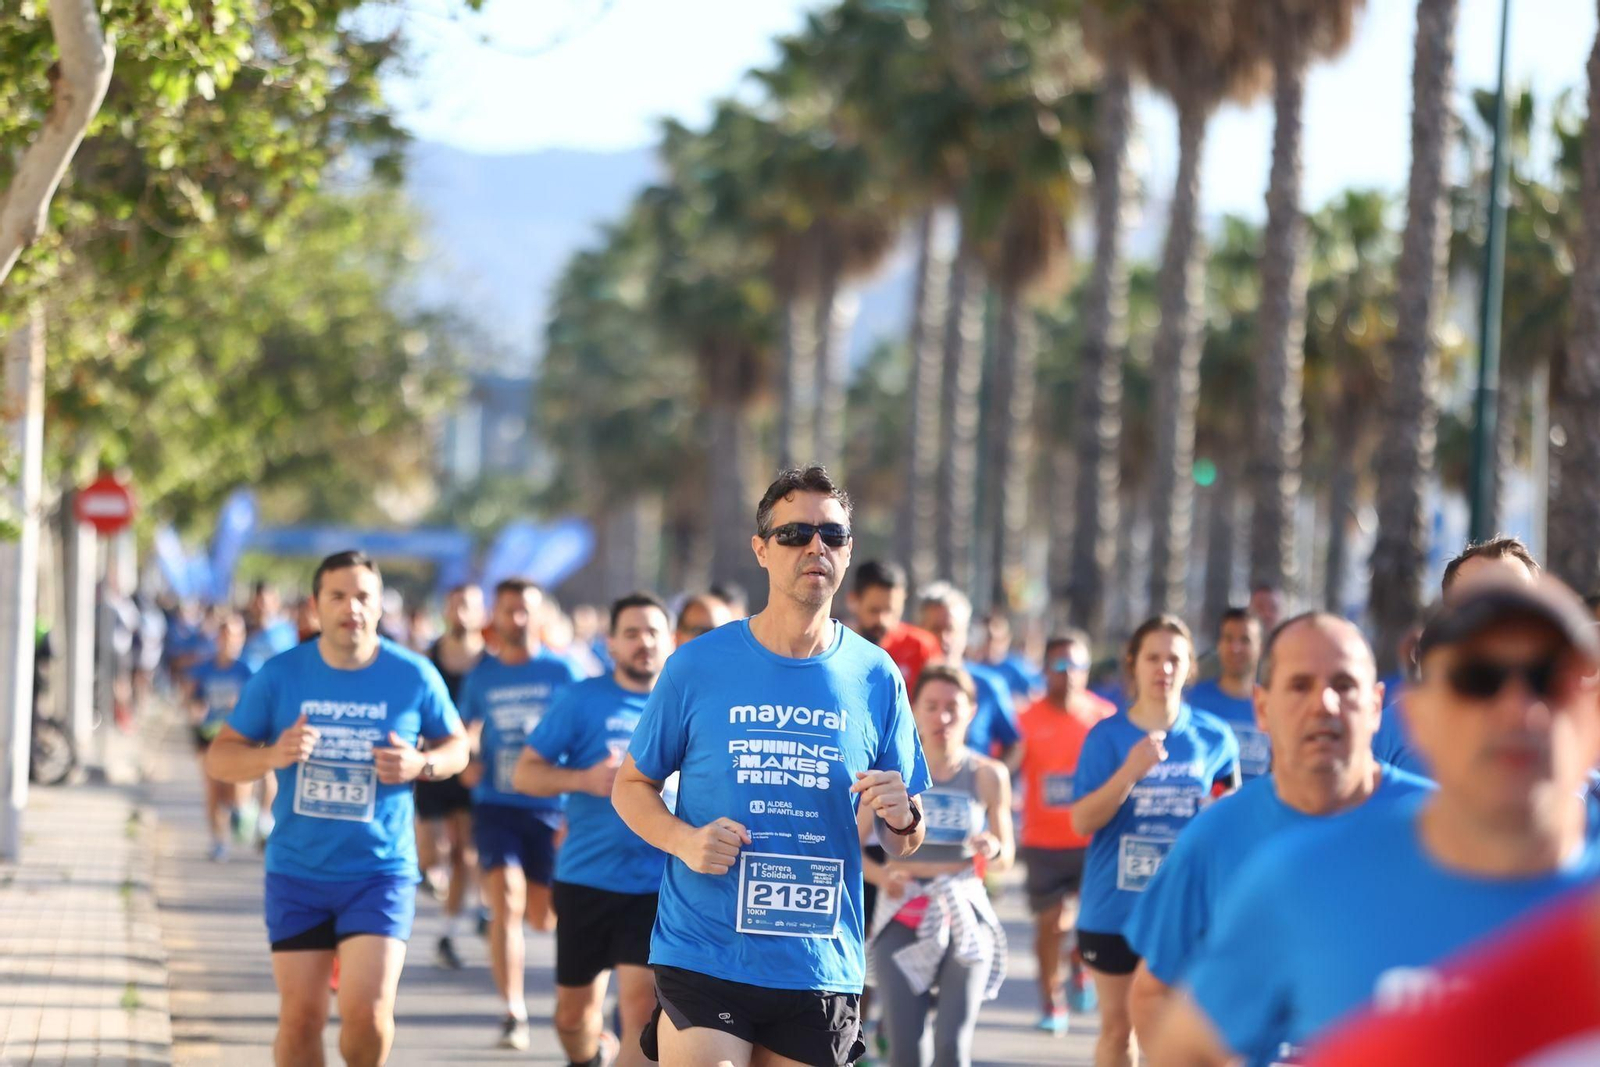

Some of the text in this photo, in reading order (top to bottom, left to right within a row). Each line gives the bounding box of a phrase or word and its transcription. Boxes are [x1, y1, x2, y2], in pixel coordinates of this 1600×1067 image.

[301, 700, 387, 720] mayoral
[730, 705, 847, 732] mayoral
[729, 740, 839, 761] RUNNING
[740, 754, 829, 774] MAKES
[737, 770, 830, 790] FRIENDS
[308, 782, 364, 801] 2113
[767, 801, 792, 809] ALDEAS
[767, 807, 804, 817] INFANTILES
[761, 870, 796, 880] Solidaria
[762, 863, 791, 872] Carrera
[811, 864, 837, 872] mayoral
[754, 884, 829, 911] 2132
[747, 908, 766, 916] 10KM
